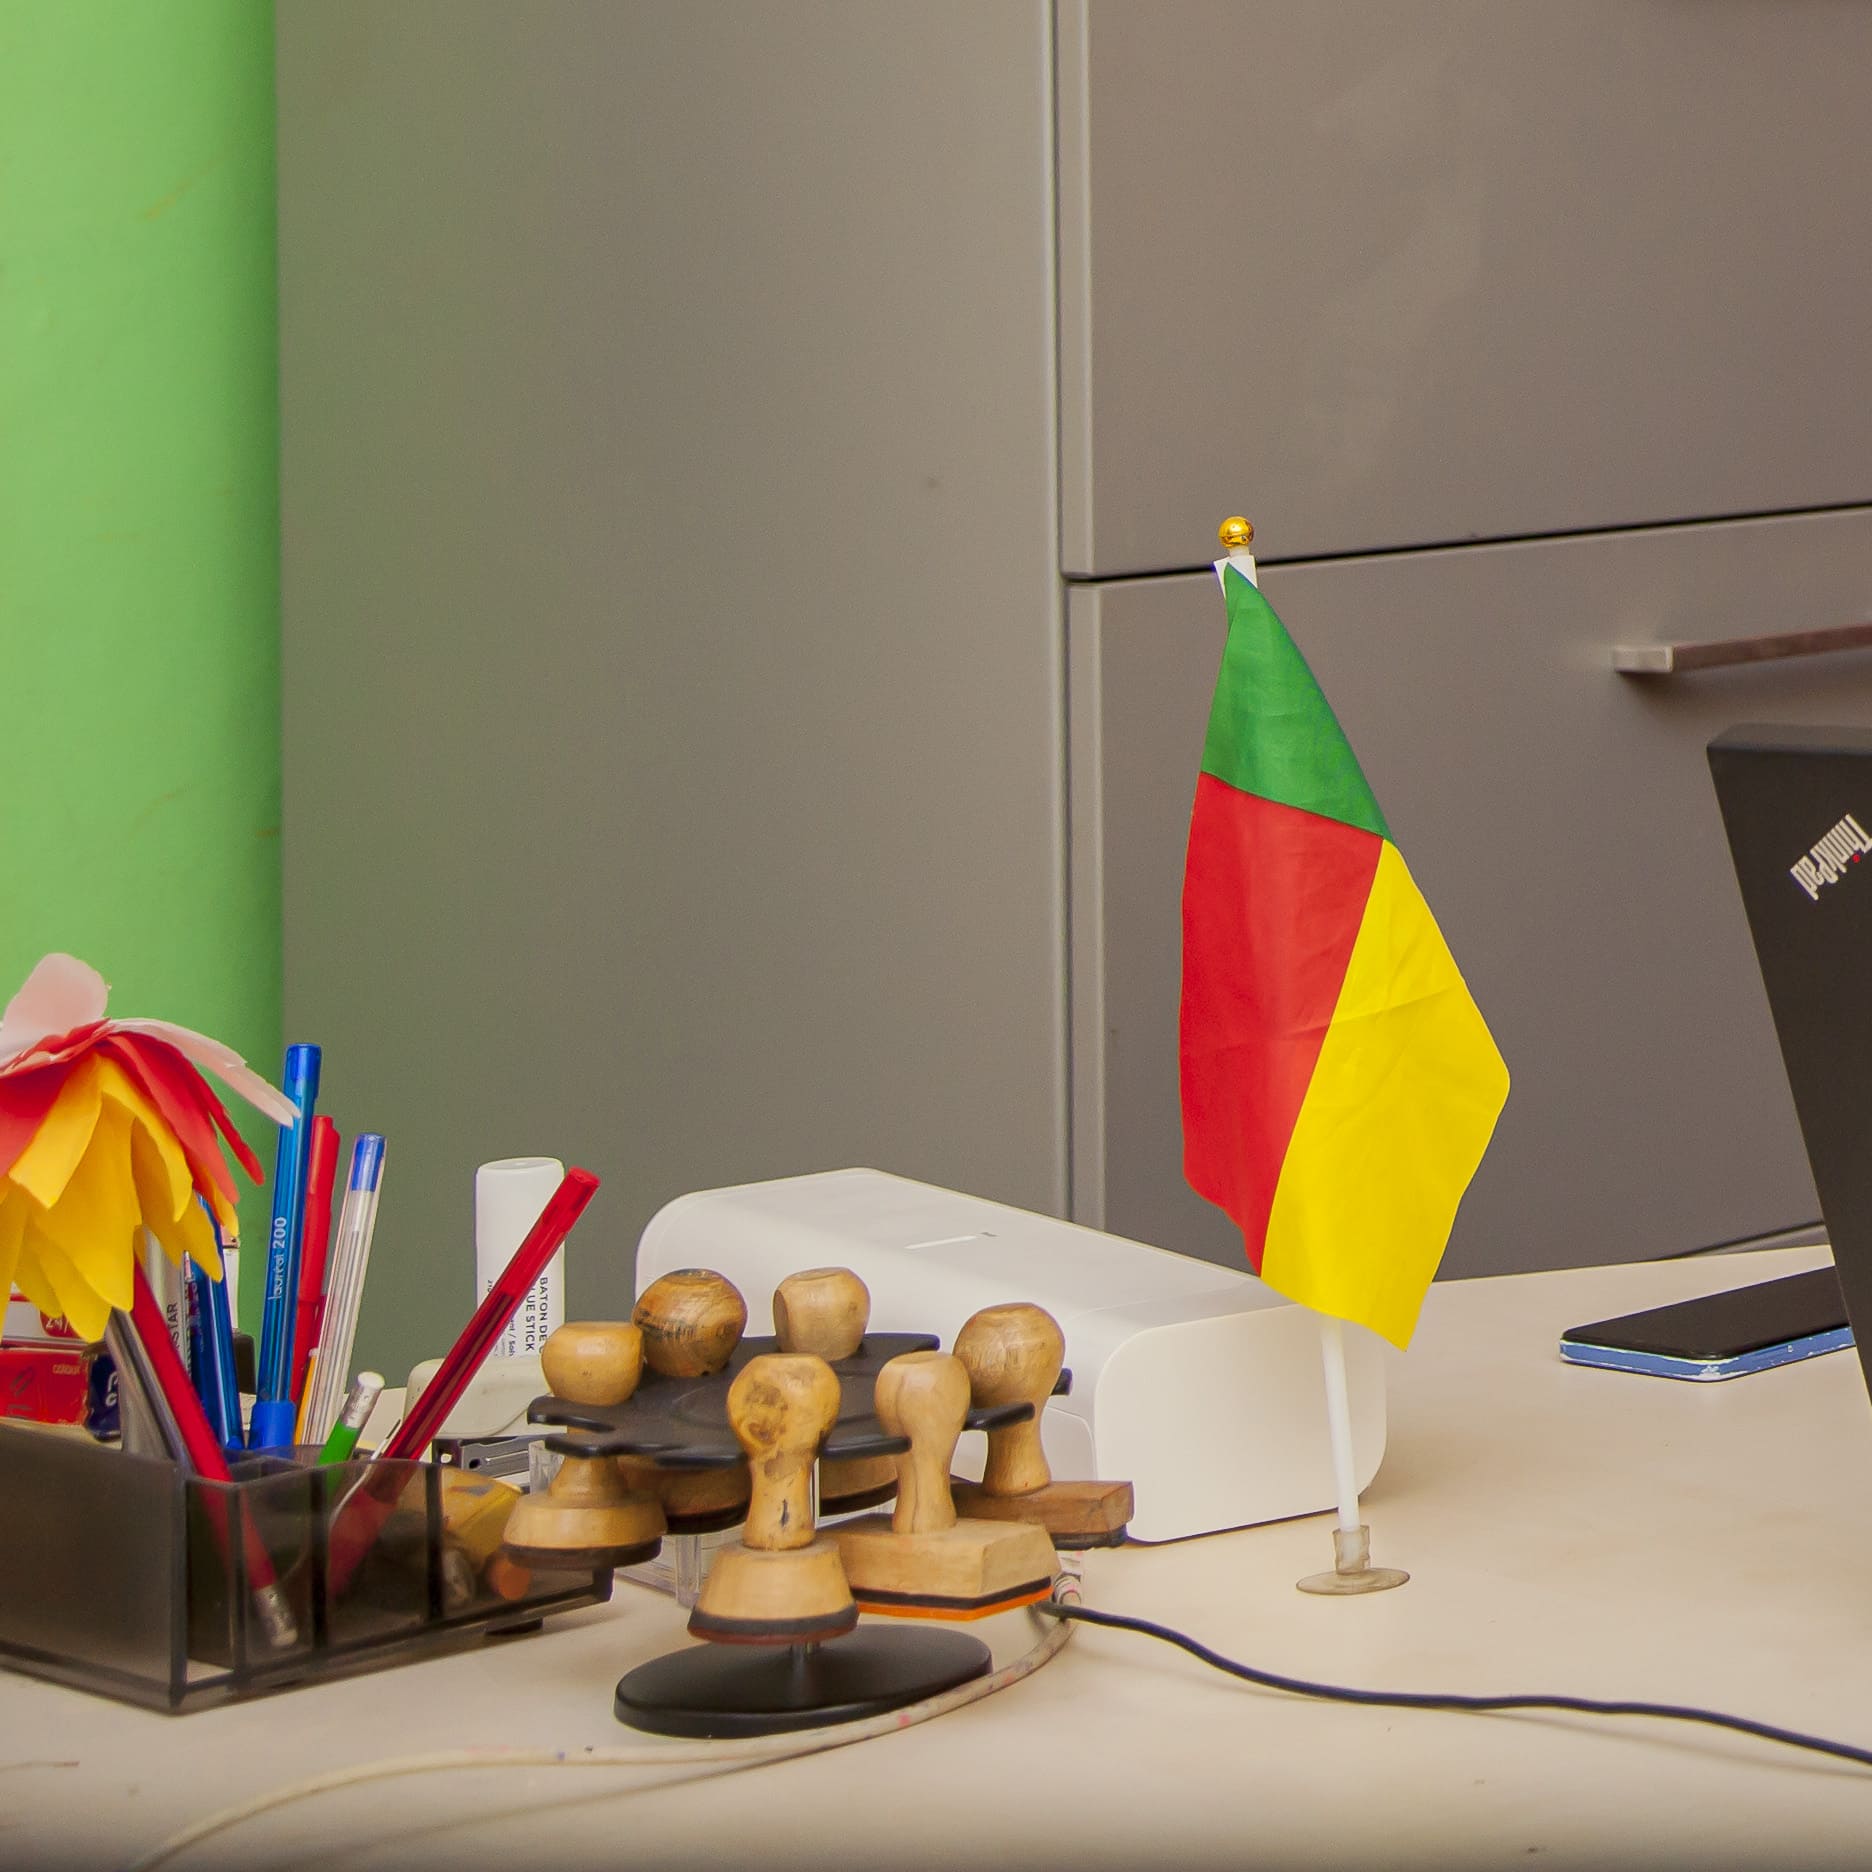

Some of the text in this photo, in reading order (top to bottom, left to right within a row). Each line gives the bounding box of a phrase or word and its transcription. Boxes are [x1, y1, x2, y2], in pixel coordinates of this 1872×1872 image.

[272, 1216, 287, 1249] 200
[539, 1277, 549, 1322] BATON
[166, 1302, 180, 1350] STAR
[525, 1315, 536, 1352] STICK
[538, 1325, 548, 1342] DE
